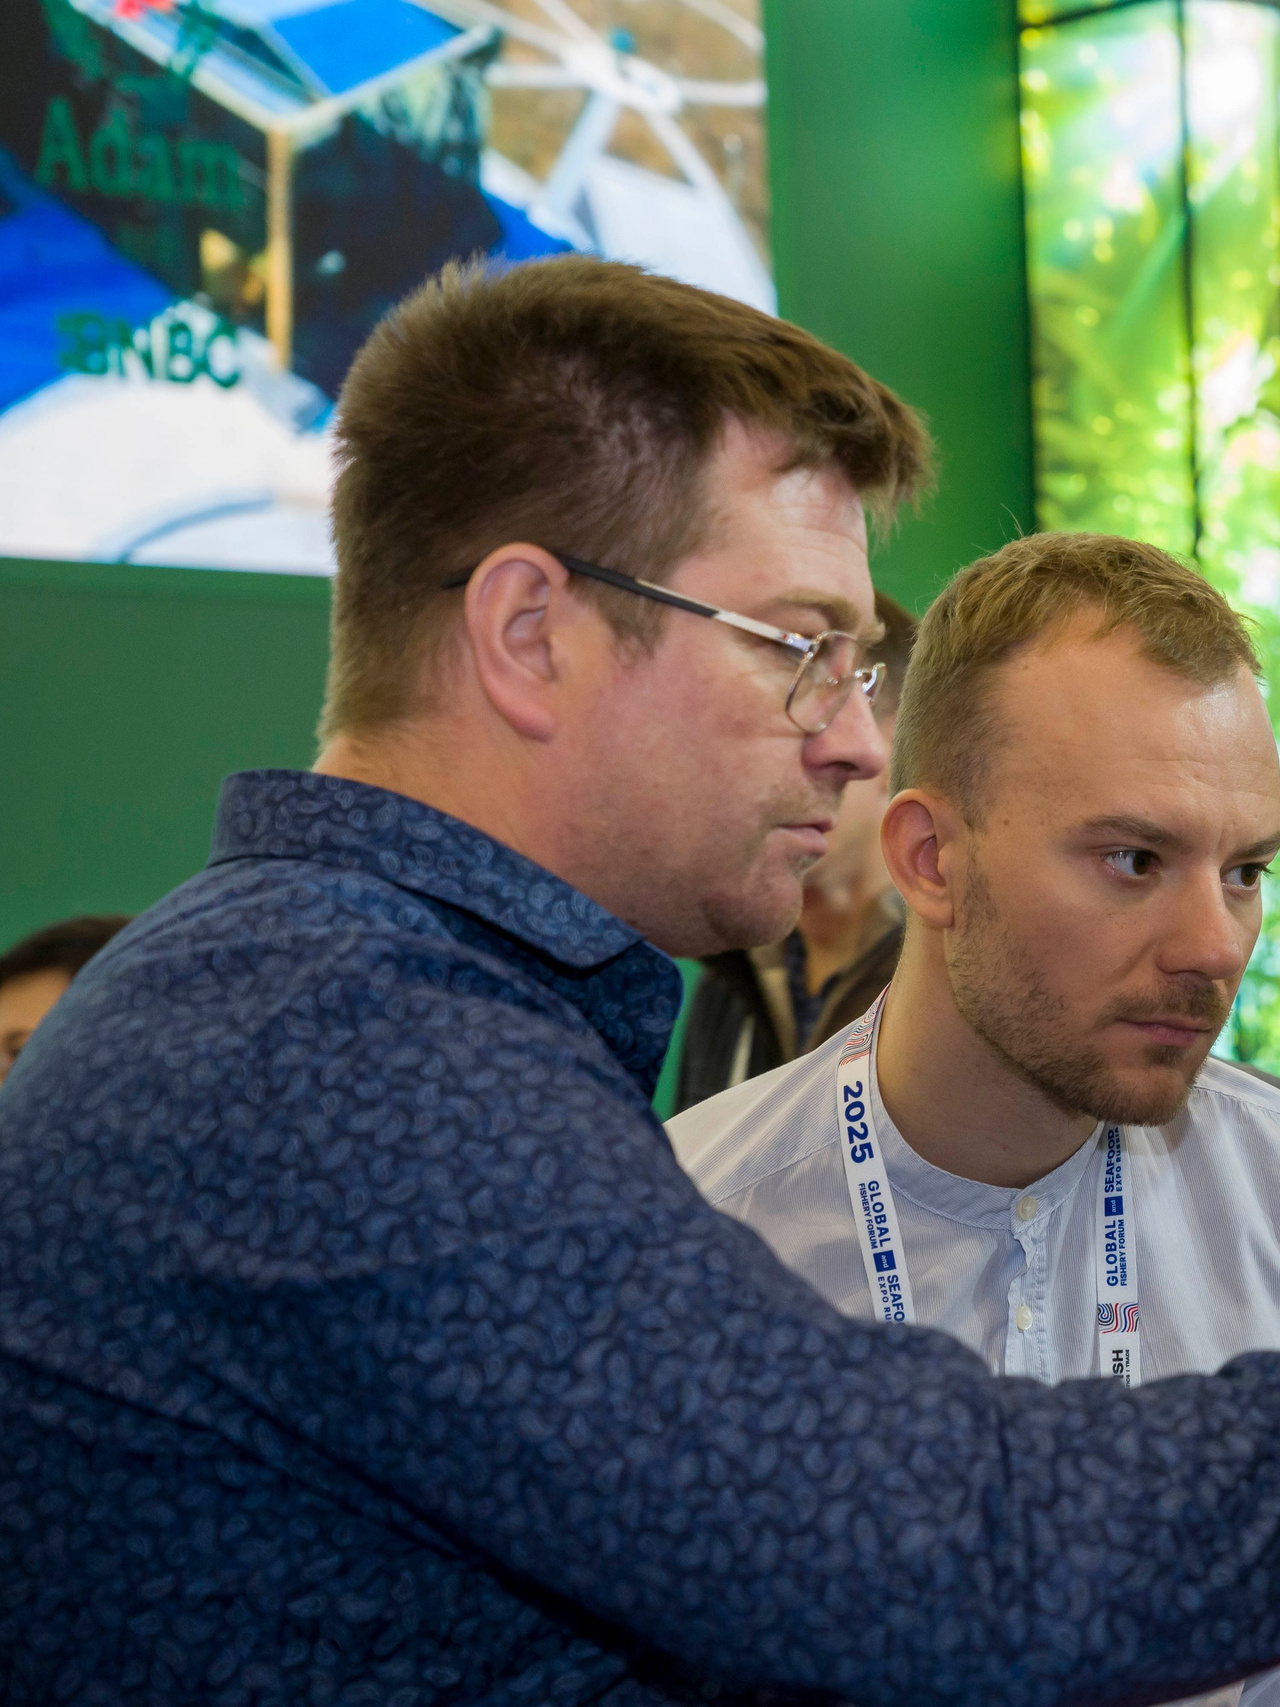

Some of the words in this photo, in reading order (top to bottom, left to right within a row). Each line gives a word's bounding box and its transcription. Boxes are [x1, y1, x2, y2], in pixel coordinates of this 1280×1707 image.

[34, 95, 245, 211] Adam
[843, 1080, 875, 1163] 2025
[1104, 1129, 1115, 1193] SEAFOOD
[858, 1182, 871, 1217] FISHERY
[865, 1218, 878, 1250] FORUM
[868, 1180, 892, 1248] GLOBAL
[1117, 1218, 1126, 1250] FORUM
[881, 1254, 889, 1269] and
[1104, 1219, 1119, 1287] GLOBAL
[1119, 1250, 1128, 1287] FISHERY
[877, 1276, 889, 1303] EXPO
[884, 1307, 892, 1324] RU
[887, 1274, 905, 1324] SEAFO
[1112, 1349, 1124, 1379] ISH
